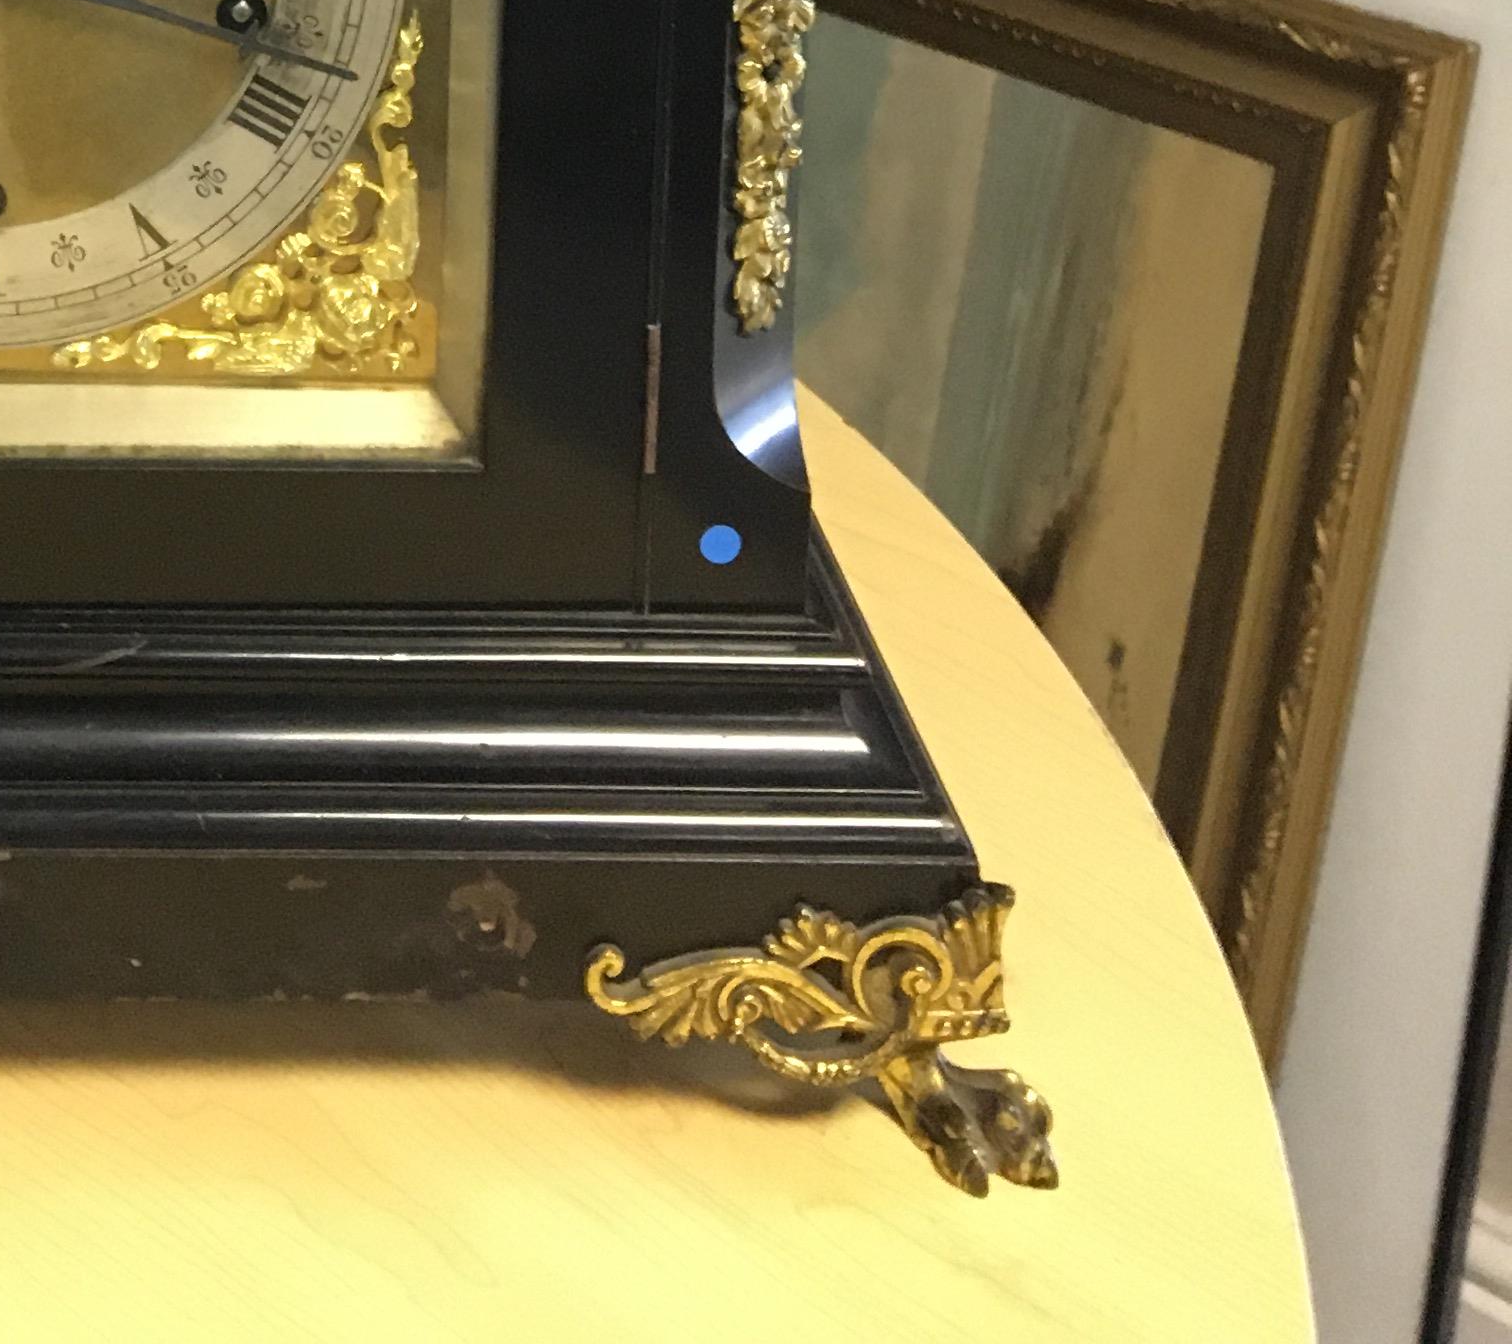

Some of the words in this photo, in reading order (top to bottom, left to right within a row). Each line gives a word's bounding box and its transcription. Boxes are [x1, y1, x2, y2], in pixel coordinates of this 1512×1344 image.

[225, 69, 315, 154] IIII
[311, 124, 343, 160] 20
[129, 202, 178, 262] V
[162, 265, 198, 295] 25
